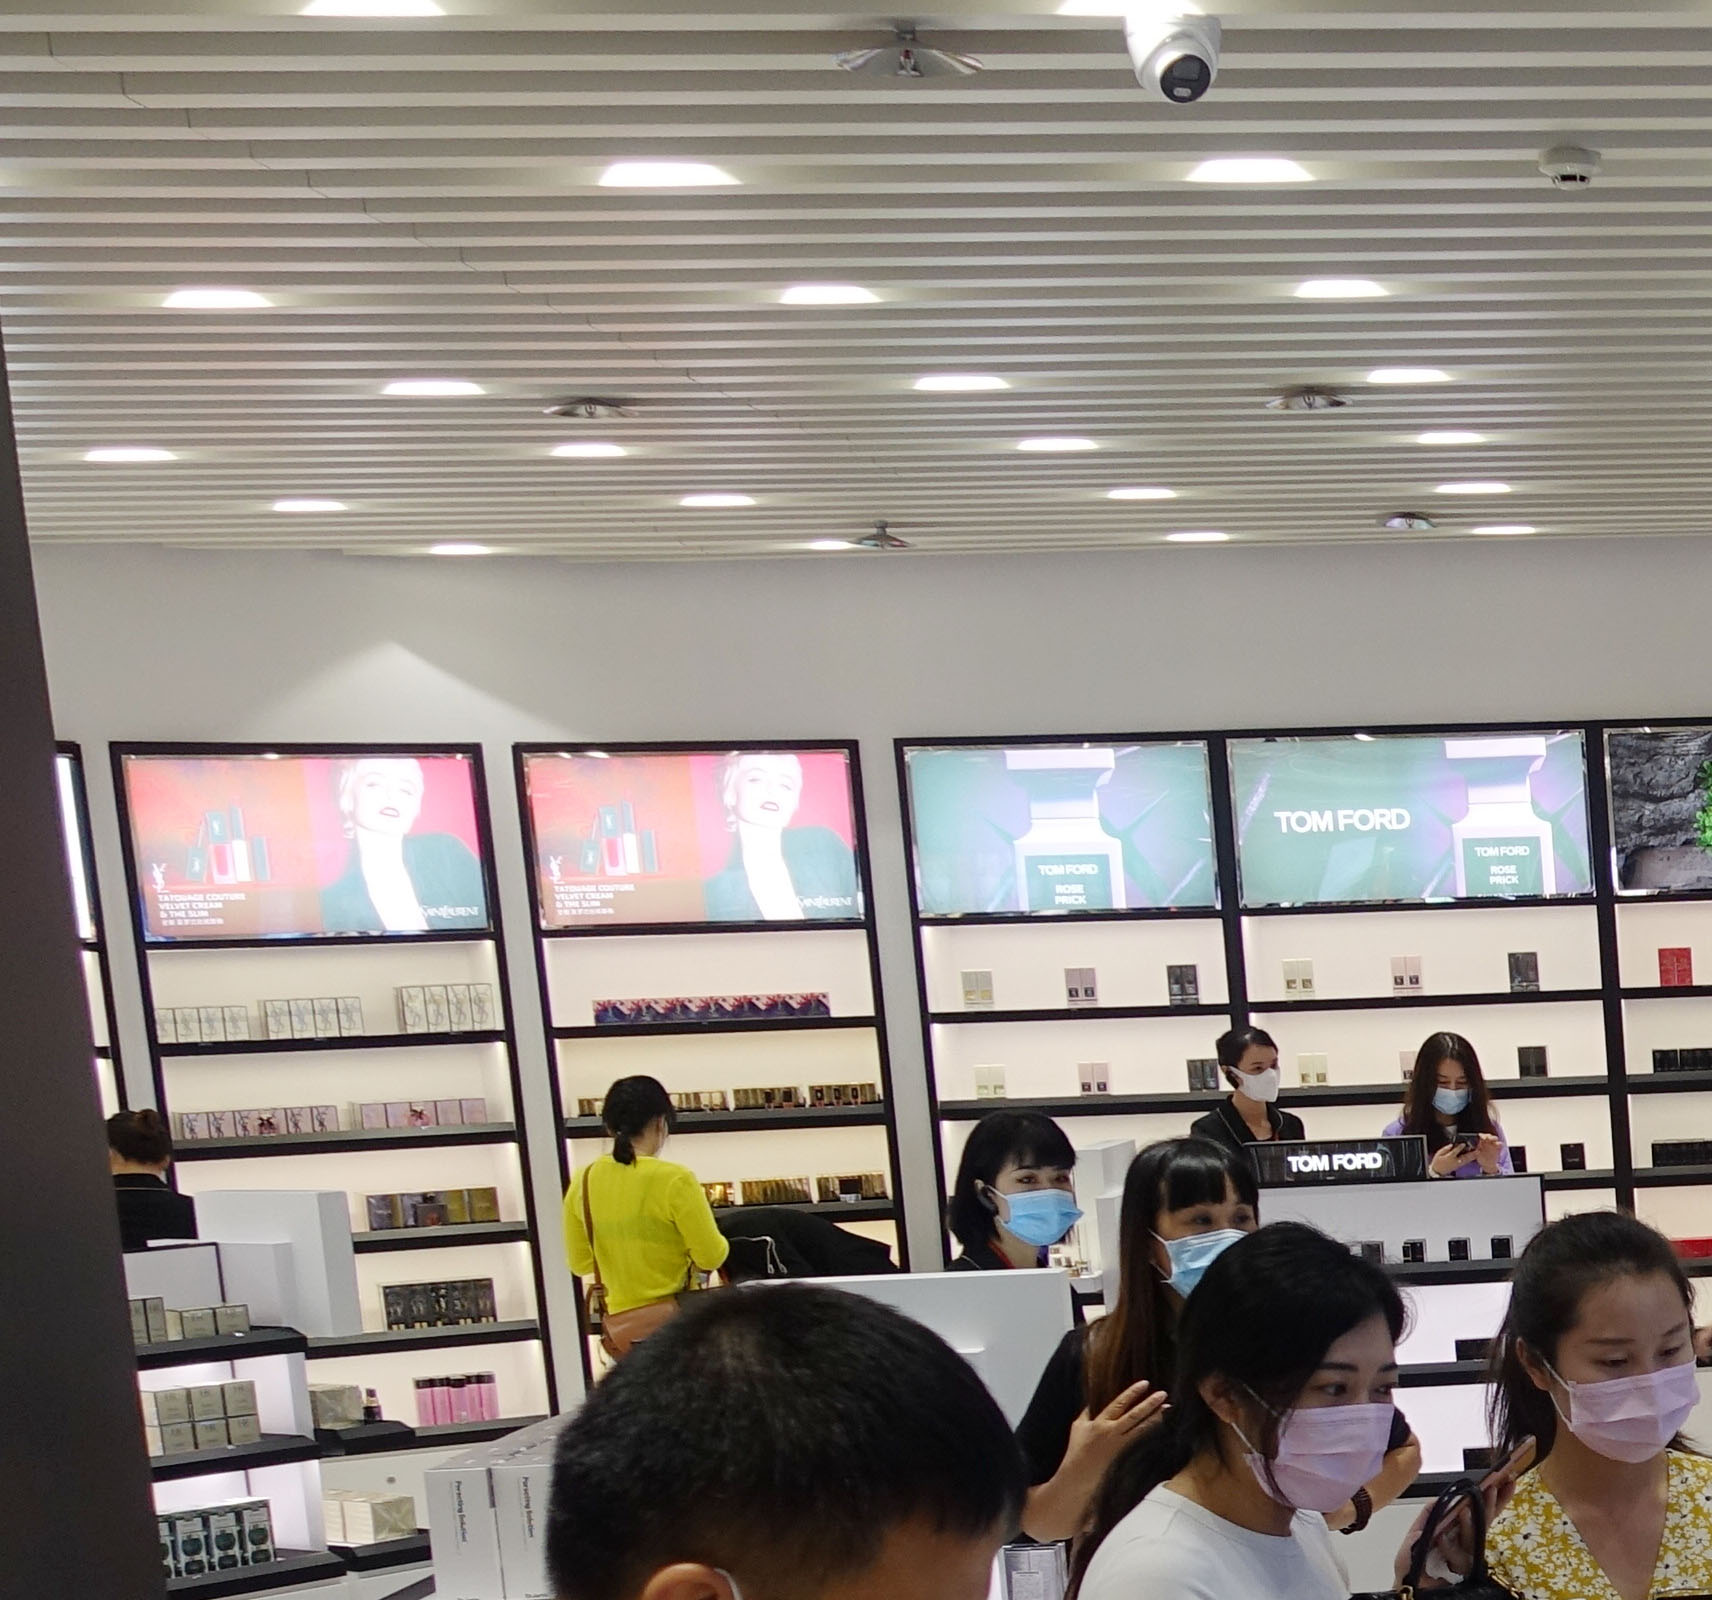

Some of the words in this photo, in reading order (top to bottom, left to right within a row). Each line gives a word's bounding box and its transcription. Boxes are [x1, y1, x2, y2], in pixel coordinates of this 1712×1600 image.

[1274, 810, 1335, 833] TOM
[1338, 808, 1411, 832] FORD
[1474, 846, 1499, 857] TOM
[1500, 845, 1530, 857] FORD
[1038, 863, 1065, 876] TOM
[1065, 863, 1099, 876] FORD
[1489, 865, 1518, 875] ROSE
[1489, 874, 1519, 885] PRICK
[1055, 884, 1085, 895] ROSE
[555, 893, 584, 901] VELVET
[1055, 895, 1087, 906] PRICK
[158, 902, 190, 910] VELVET
[191, 902, 223, 910] CREAM
[563, 900, 580, 908] THE
[168, 910, 186, 918] THE
[187, 910, 209, 918] SLIM
[1287, 1154, 1330, 1172] TOM
[1332, 1152, 1382, 1171] FORD
